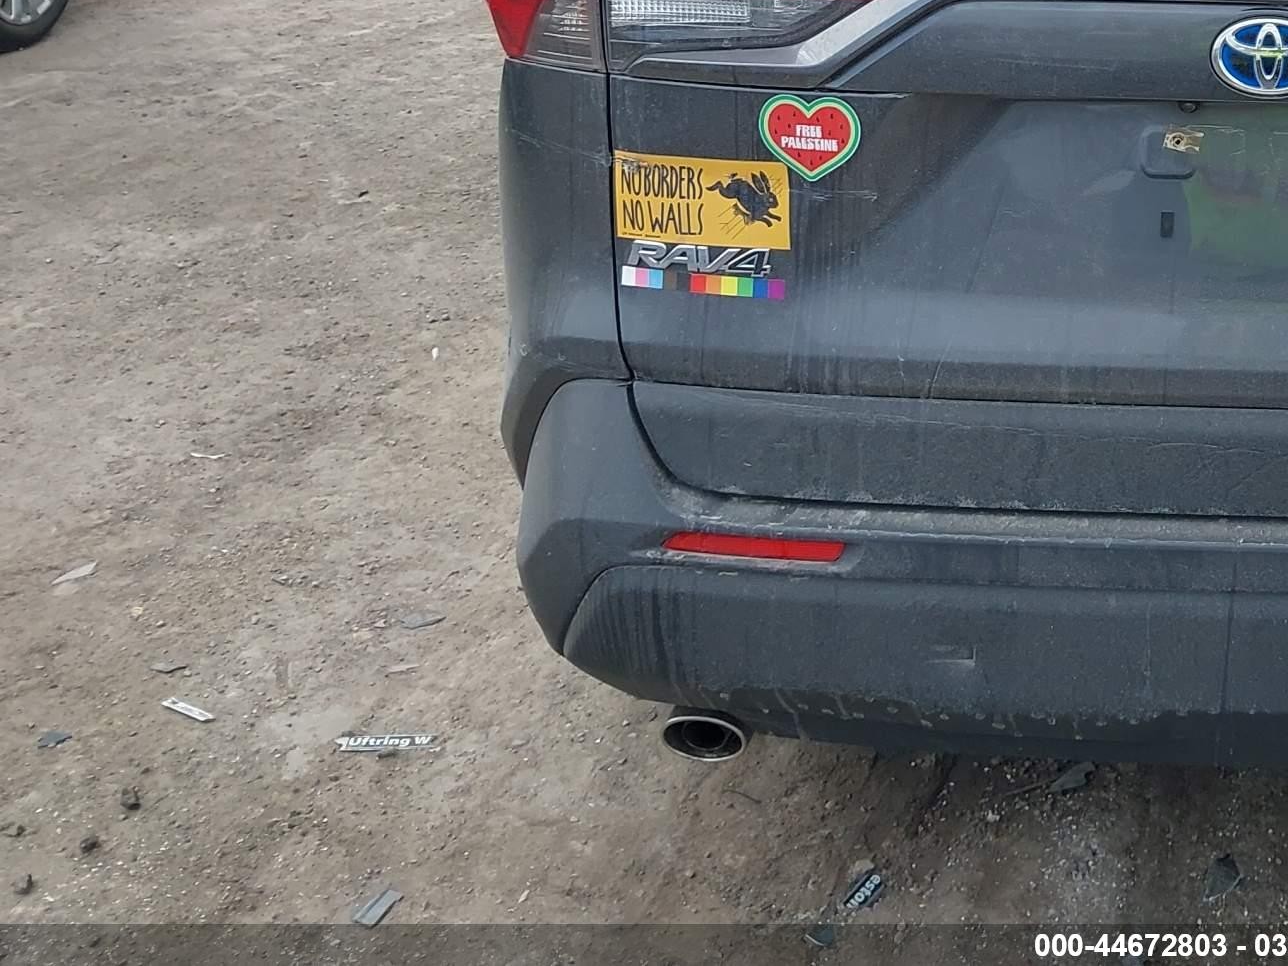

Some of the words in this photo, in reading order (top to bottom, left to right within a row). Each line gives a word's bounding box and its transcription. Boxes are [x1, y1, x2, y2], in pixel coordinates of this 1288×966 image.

[781, 136, 839, 152] PALESTINE
[796, 124, 823, 138] FREE
[621, 162, 642, 197] NO
[644, 163, 704, 200] BORDERS
[622, 198, 645, 232] NO
[647, 201, 704, 236] WALLS
[627, 240, 772, 278] RAV4
[348, 736, 412, 748] Uftring
